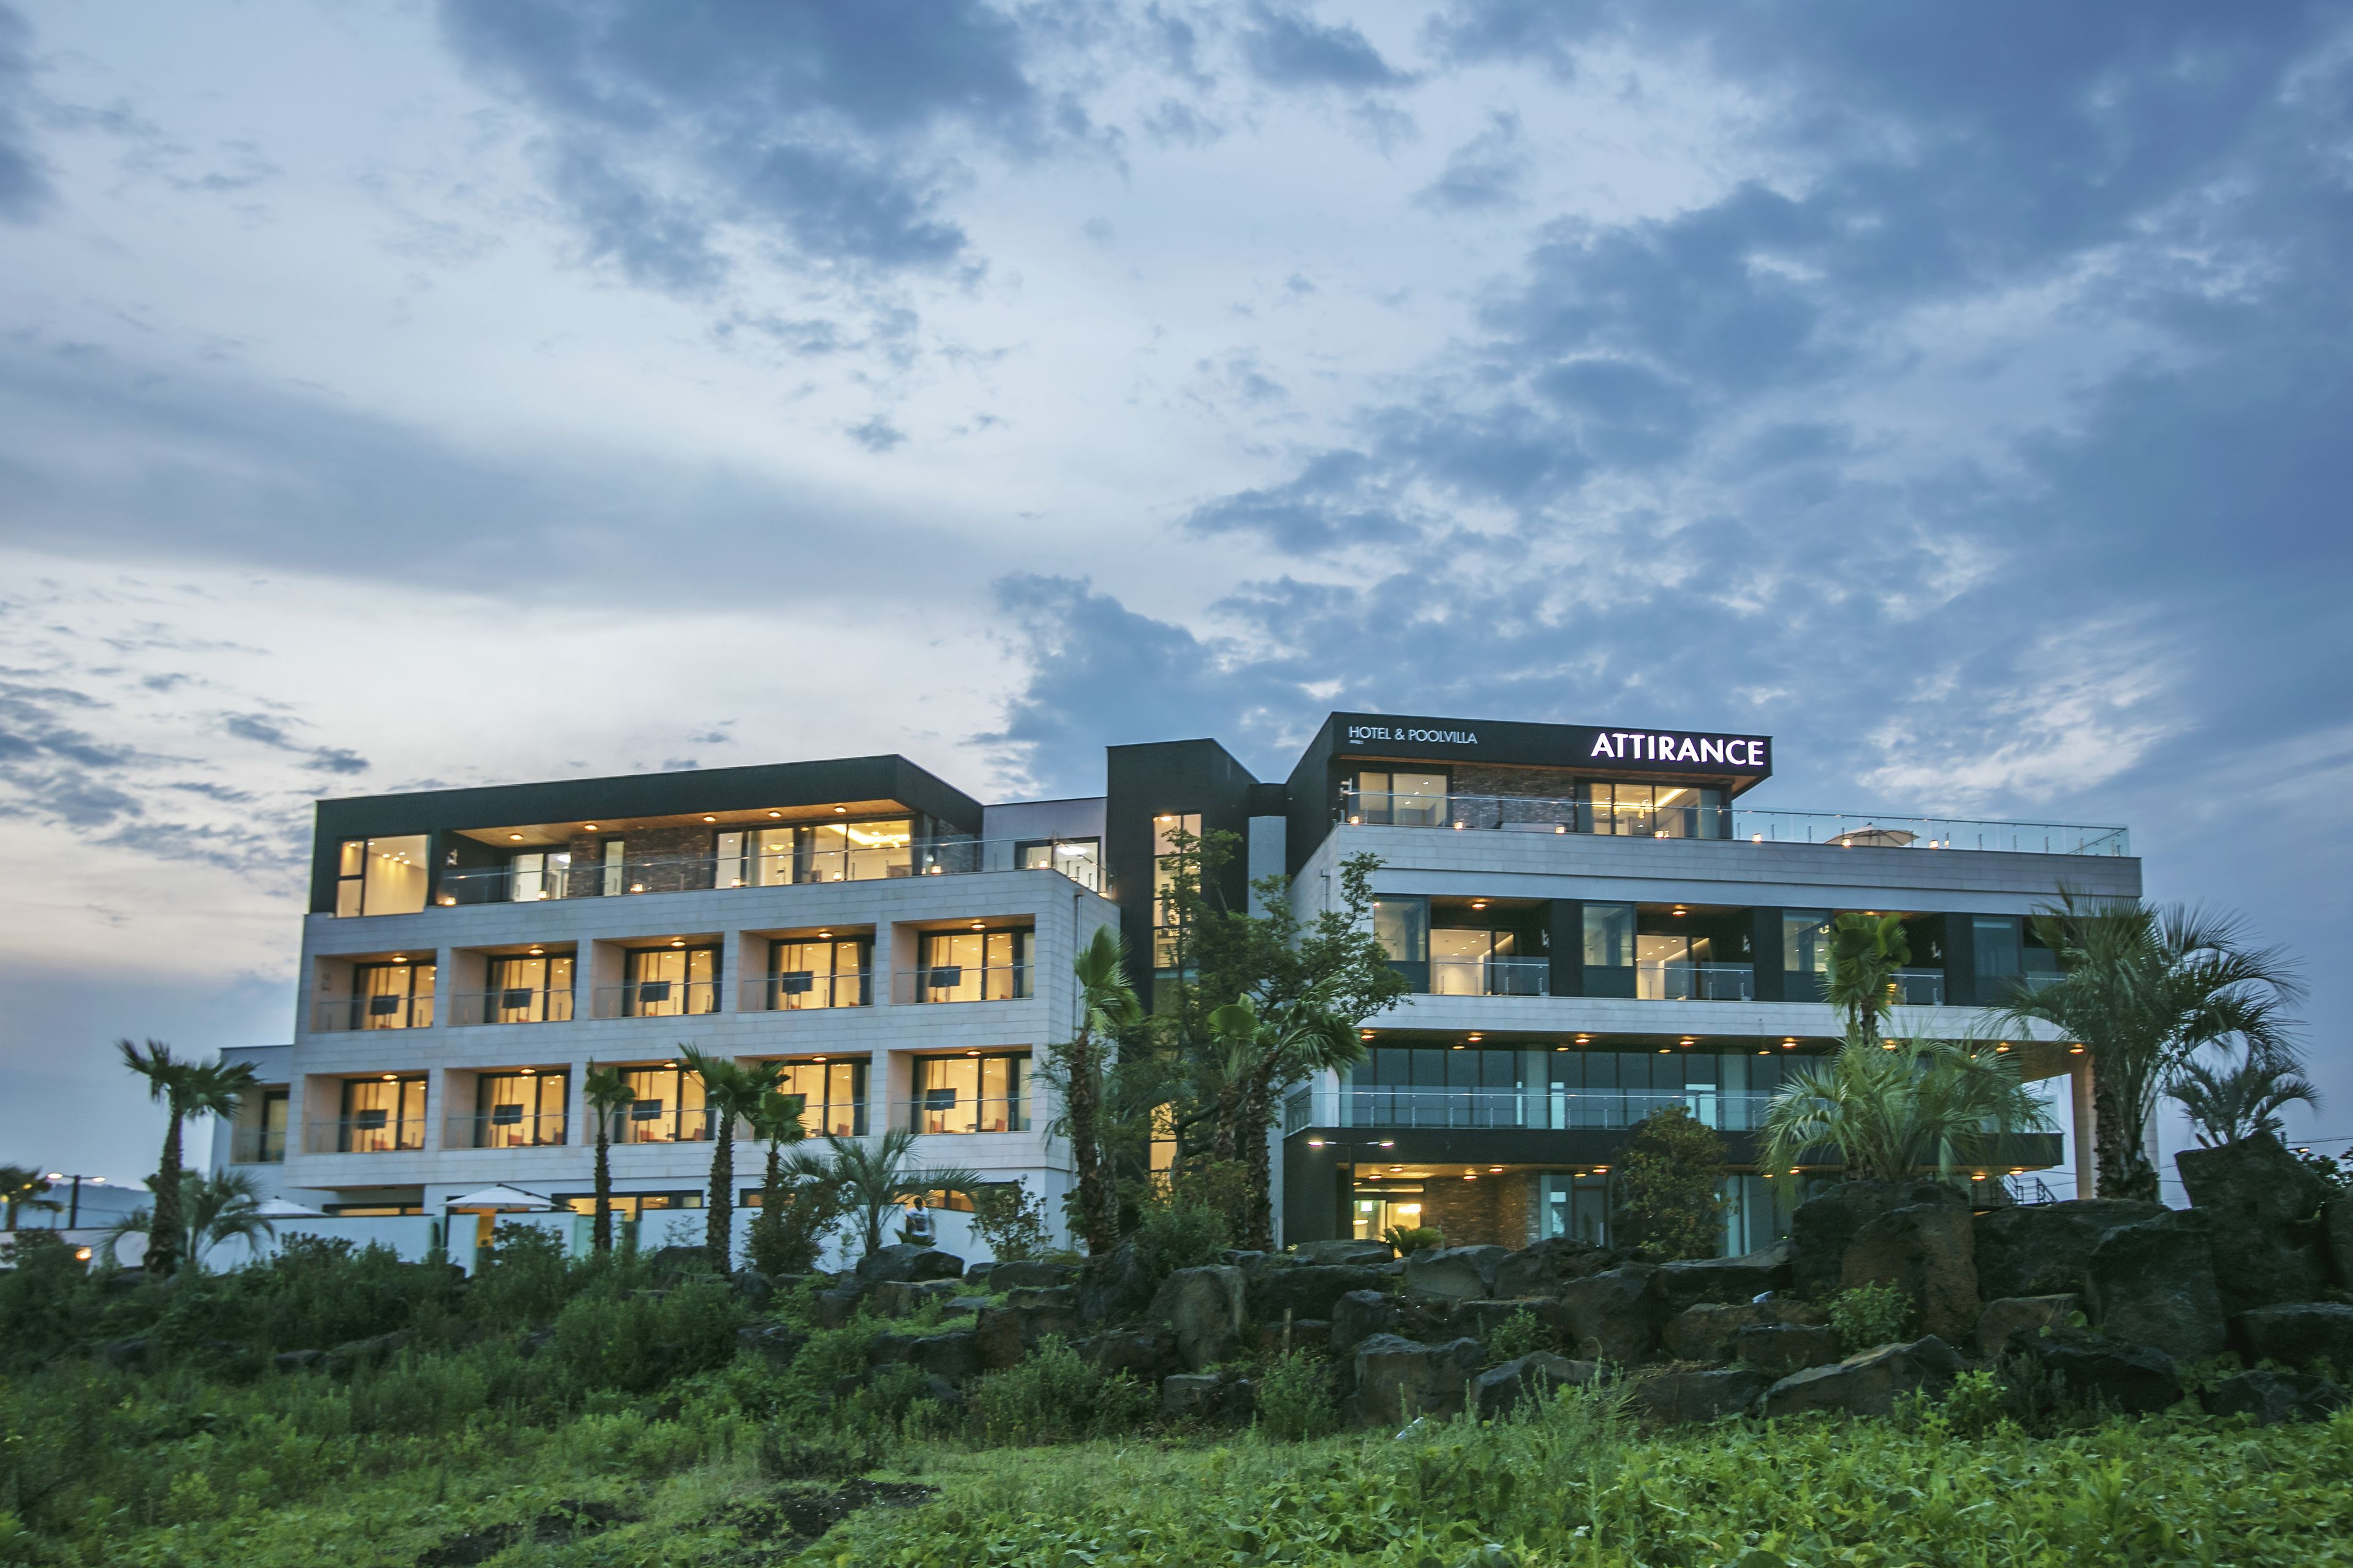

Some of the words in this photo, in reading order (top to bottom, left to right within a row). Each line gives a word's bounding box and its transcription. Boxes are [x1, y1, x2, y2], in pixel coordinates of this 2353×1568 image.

[1348, 725, 1392, 740] HOTEL
[1393, 728, 1405, 740] &
[1408, 729, 1478, 744] POOLVILLA
[1590, 732, 1764, 766] ATTIRANCE
